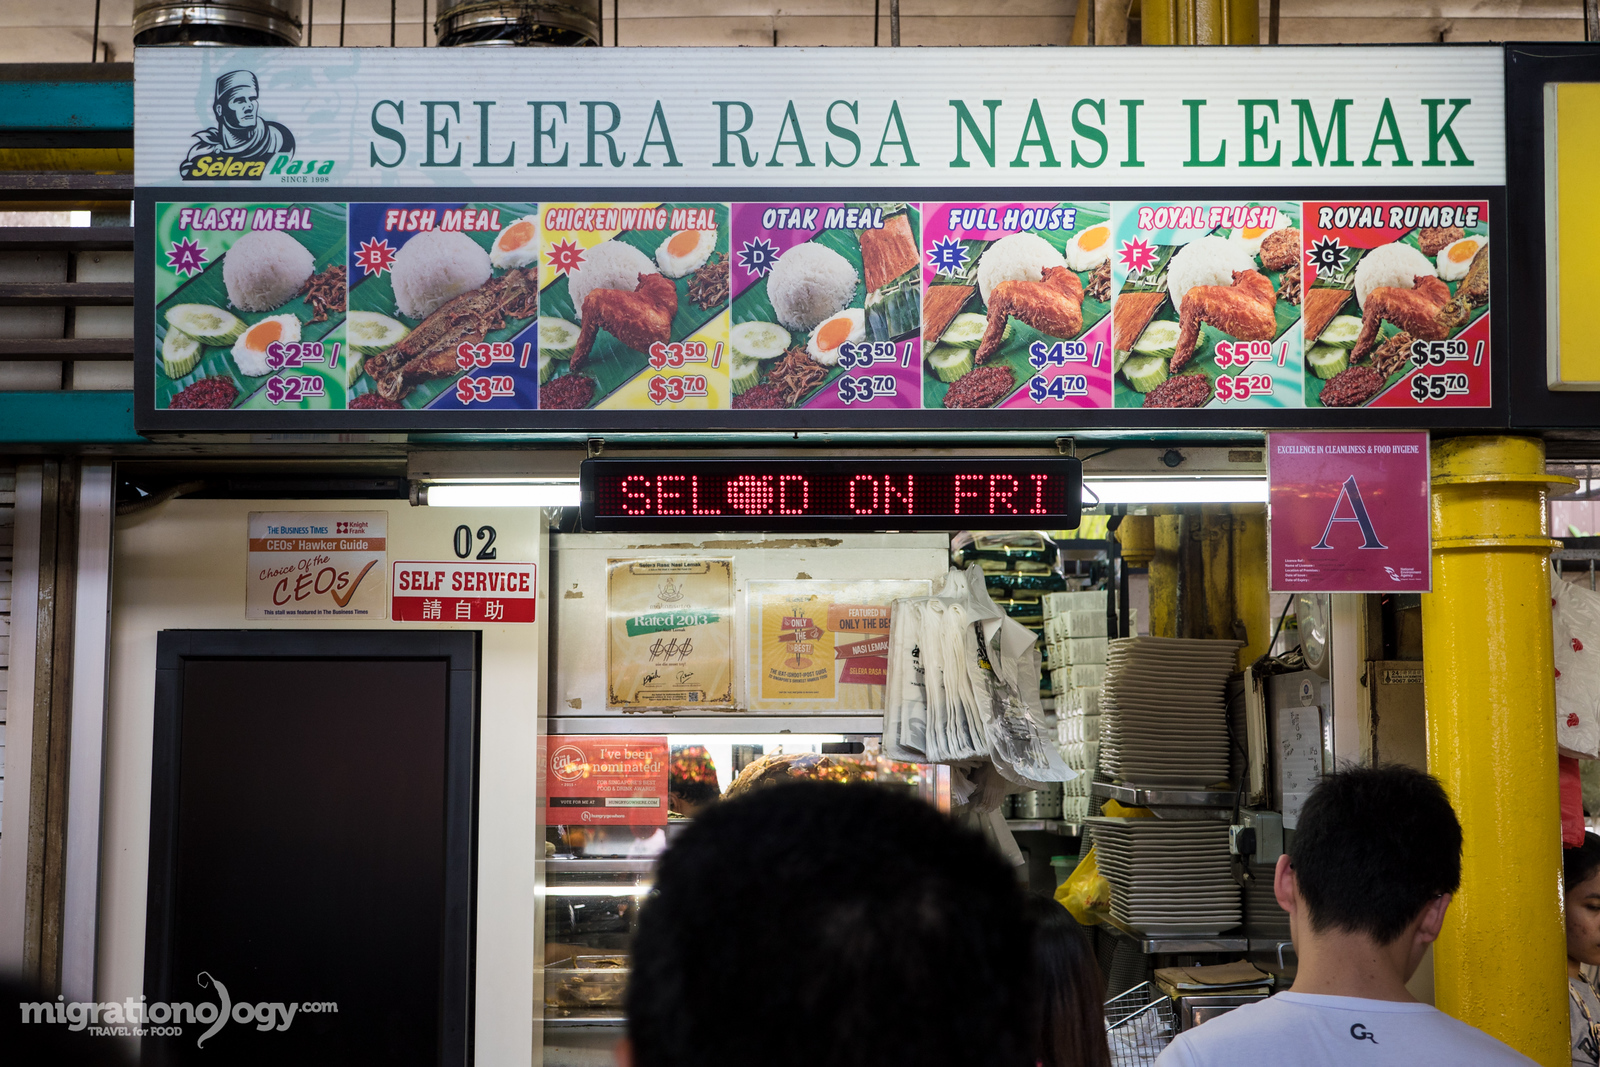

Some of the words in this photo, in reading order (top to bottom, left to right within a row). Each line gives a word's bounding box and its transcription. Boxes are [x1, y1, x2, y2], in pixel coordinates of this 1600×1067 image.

[370, 99, 684, 168] SELERA
[711, 99, 921, 168] RASA
[949, 97, 1146, 169] NASI
[1181, 97, 1475, 168] LEMAK
[269, 155, 335, 175] Rasa
[179, 208, 248, 231] FLASH
[251, 208, 313, 231] MEAL
[386, 209, 437, 232] FISH
[440, 209, 502, 232] MEAL
[545, 208, 618, 231] CHICKEN
[621, 208, 667, 231] WING
[669, 208, 717, 231] MEAL
[762, 208, 817, 230] OTAK
[824, 208, 884, 230] MEAL
[949, 208, 999, 231] FULL
[1002, 208, 1077, 231] HOUSE
[1138, 206, 1205, 230] ROYAL
[1208, 206, 1278, 229] FLUSH
[1318, 206, 1385, 230] ROYAL
[1388, 206, 1480, 230] RUMBLE
[182, 252, 193, 264] A
[371, 252, 382, 264] B
[561, 252, 572, 264] C
[753, 252, 764, 264] D
[943, 251, 954, 263] E
[1132, 250, 1143, 262] F
[1322, 250, 1334, 262] G
[1277, 445, 1316, 454] EXCELLENCE
[1316, 445, 1324, 454] IN
[1325, 445, 1366, 454] CLEANLINESS
[1367, 446, 1372, 454] &
[1374, 445, 1391, 454] FOOD
[1392, 445, 1419, 454] HYGIENE
[850, 475, 914, 515] ON
[954, 475, 1048, 515] FRI
[1311, 474, 1389, 550] A
[267, 526, 279, 535] THE
[280, 526, 309, 535] BUSINESS
[310, 525, 329, 535] TIMES
[298, 540, 337, 550] Hawker
[339, 539, 368, 550] Guide
[453, 524, 497, 560] 02
[259, 565, 296, 580] Choice
[298, 558, 312, 573] Of
[313, 554, 331, 566] the
[273, 566, 349, 606] CEOs
[399, 570, 446, 591] SELF
[452, 571, 530, 592] SERVICE
[422, 599, 504, 620] 請自助
[848, 608, 879, 617] FEATURED
[880, 609, 886, 617] IN
[634, 614, 674, 626] Rated
[676, 615, 708, 626] 2013
[791, 618, 808, 627] ONLY
[839, 619, 860, 629] ONLY
[862, 618, 877, 629] THE
[794, 631, 807, 641] THE
[793, 643, 812, 653] BEST!
[852, 644, 868, 655] NASI
[867, 641, 889, 653] LEMAK
[849, 667, 868, 675] SELERA
[868, 667, 882, 675] RASA
[600, 748, 621, 759] I've
[624, 748, 653, 760] been
[592, 761, 661, 773] nominated!
